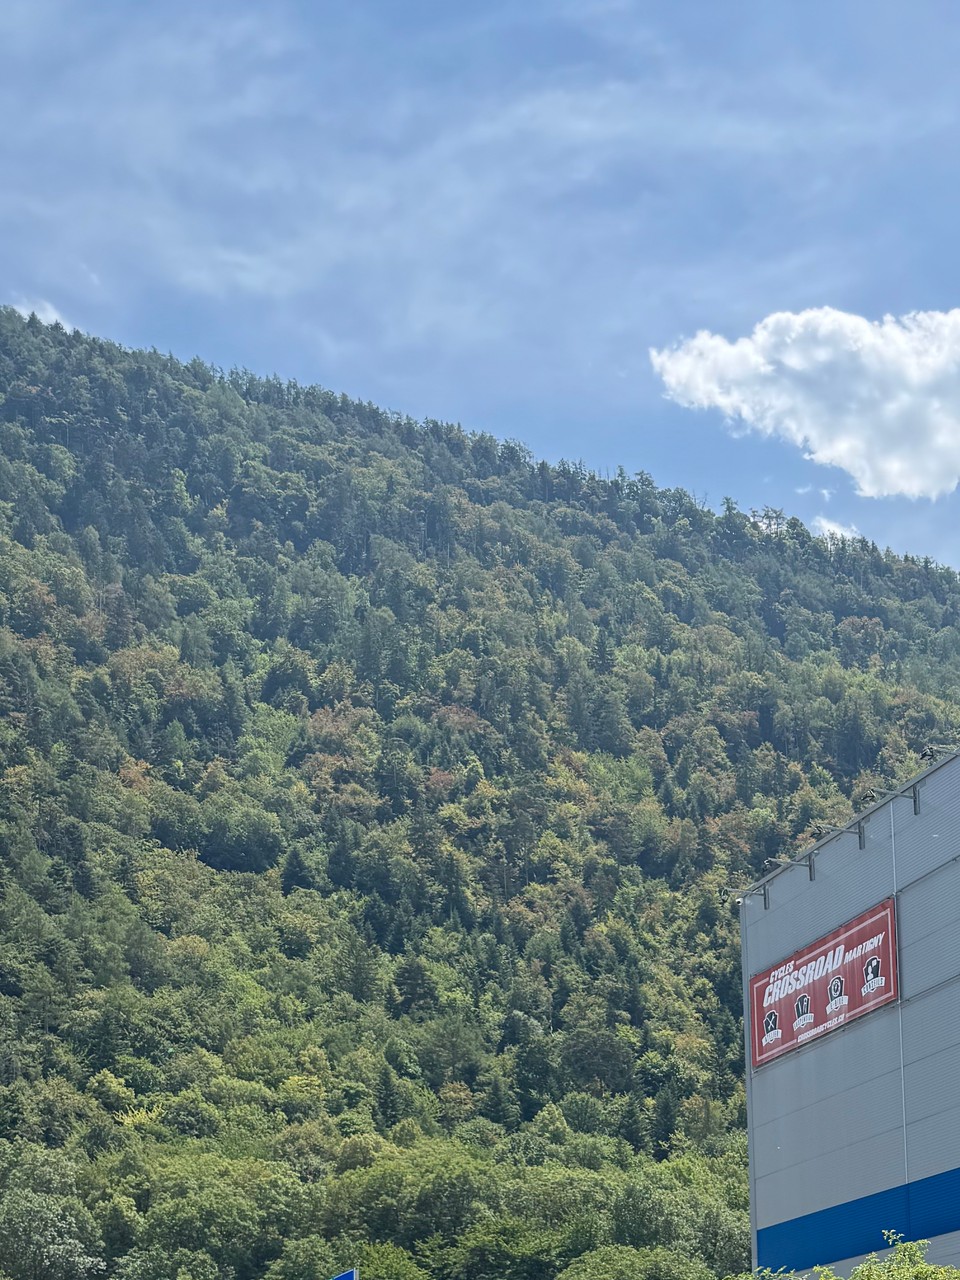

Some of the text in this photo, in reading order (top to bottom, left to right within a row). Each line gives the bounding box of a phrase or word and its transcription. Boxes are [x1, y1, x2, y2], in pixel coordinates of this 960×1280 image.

[763, 931, 886, 1008] CROSSROAD MARTIGNY
[769, 960, 795, 984] CYCLES
